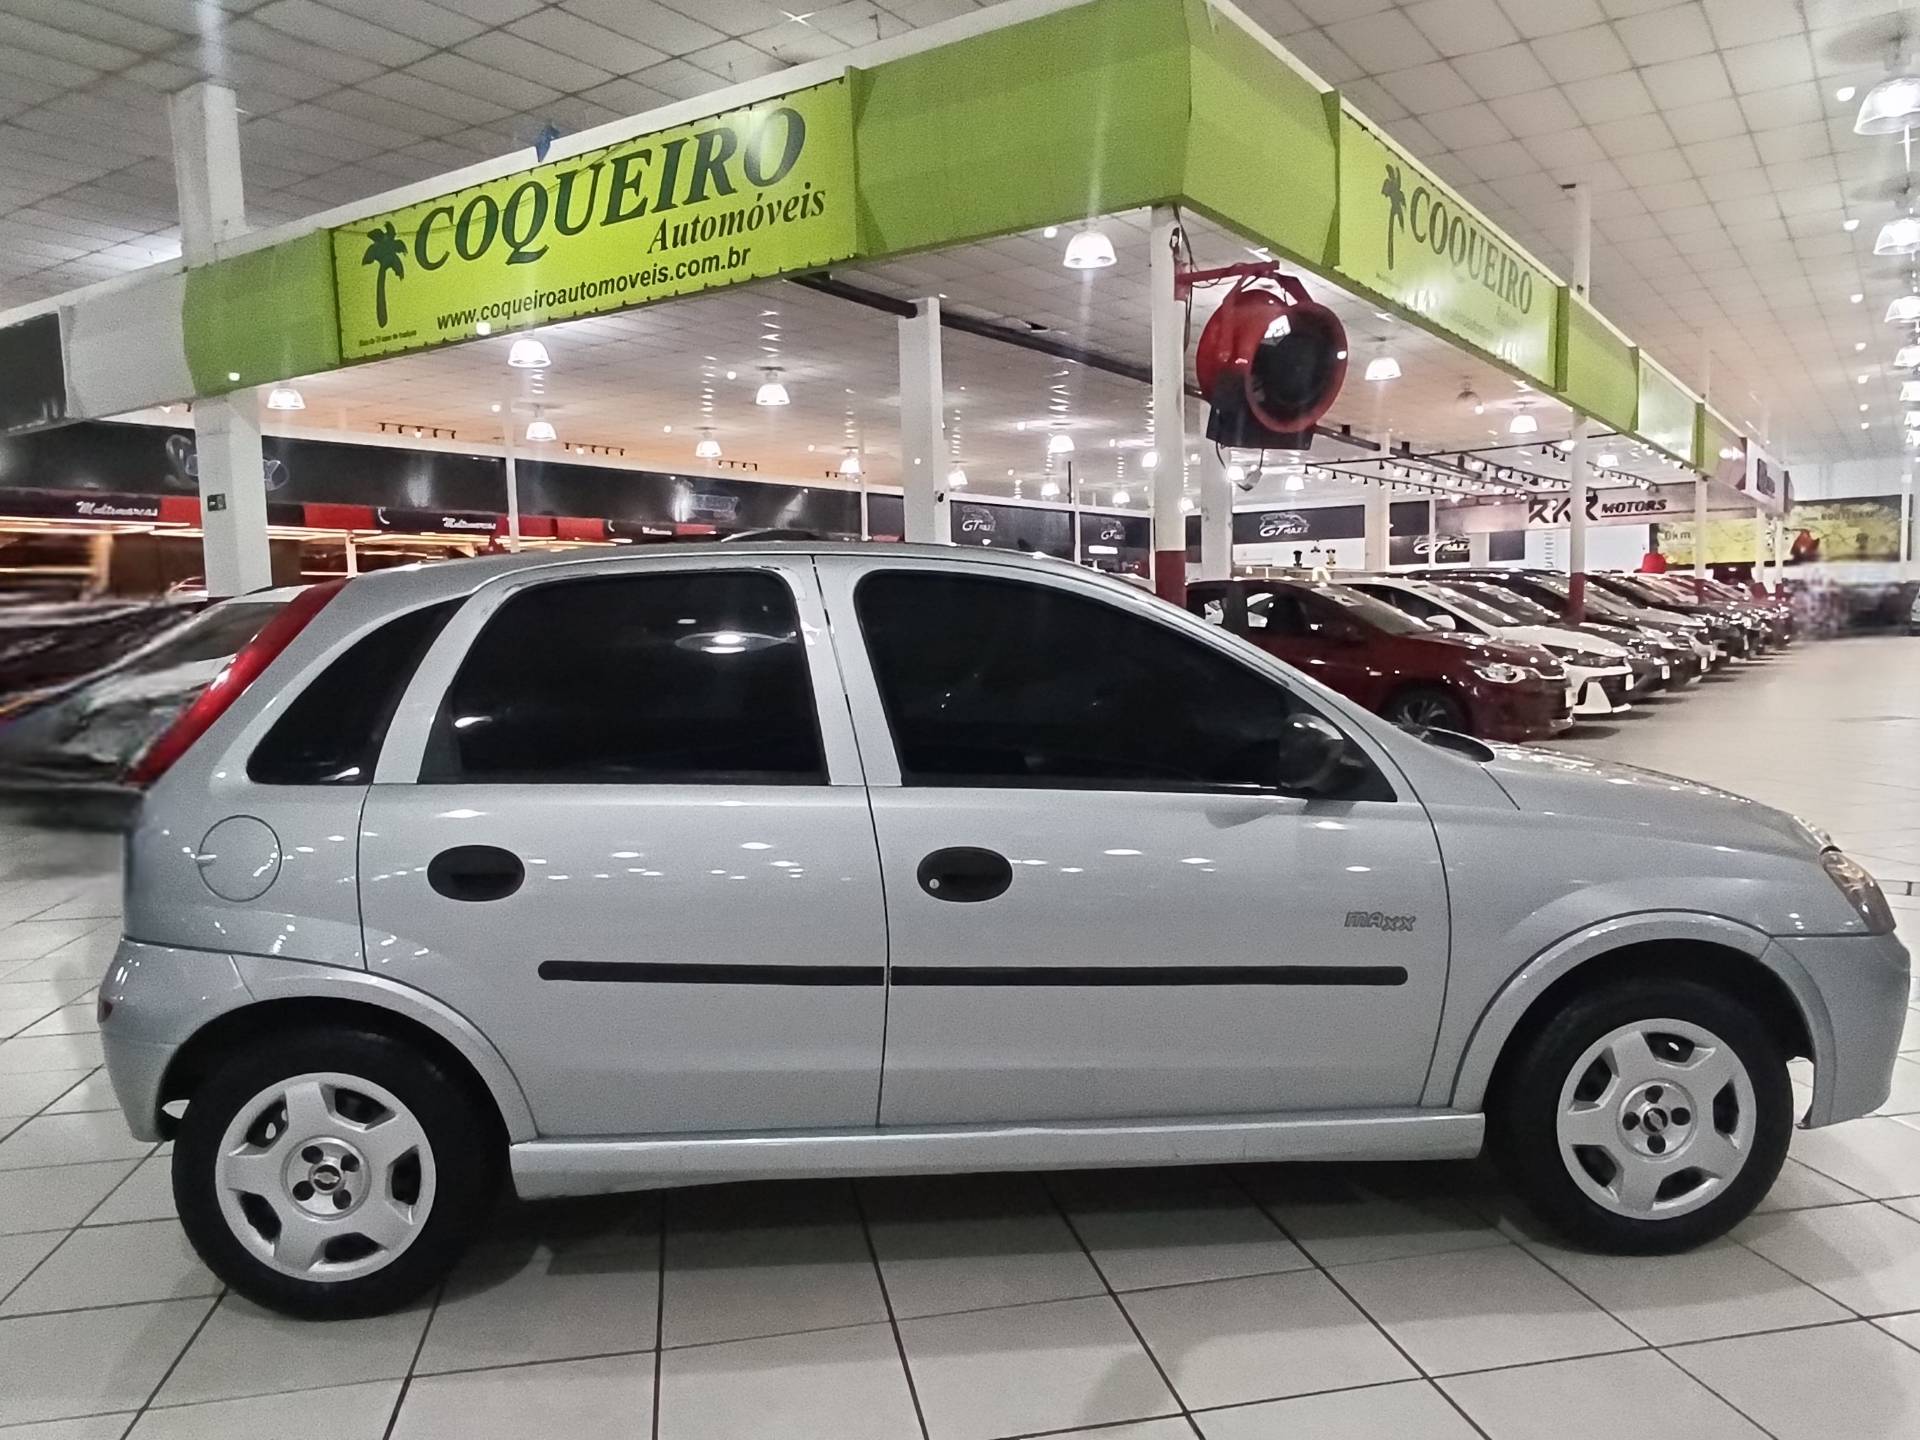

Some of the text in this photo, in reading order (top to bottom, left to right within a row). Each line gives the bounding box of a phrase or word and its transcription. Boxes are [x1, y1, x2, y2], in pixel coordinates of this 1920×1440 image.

[415, 107, 805, 271] COQUEIRO
[648, 182, 826, 254] Automóveis
[437, 243, 751, 330] www.coqueiroautomoveis.com.br
[1410, 186, 1532, 314] COQUEIRO
[1601, 499, 1667, 514] MOTORS
